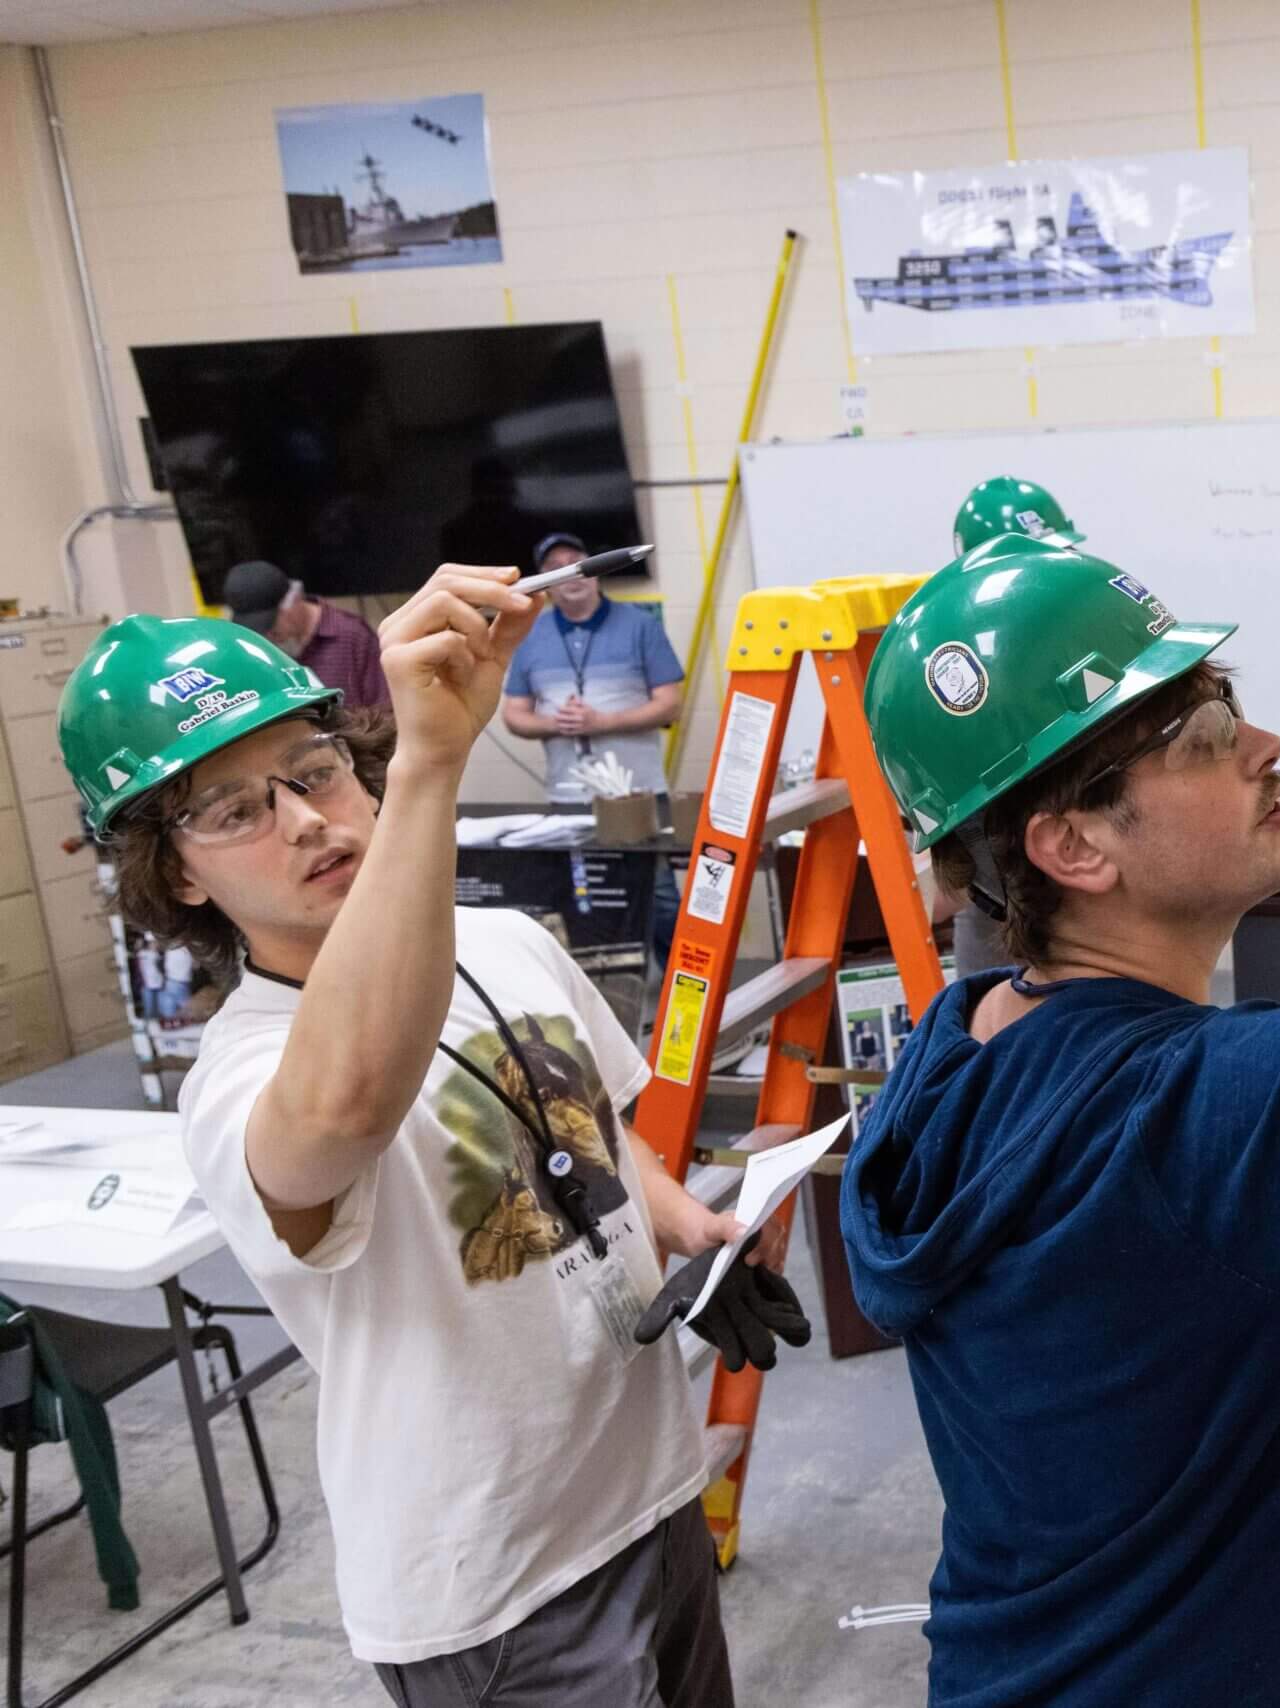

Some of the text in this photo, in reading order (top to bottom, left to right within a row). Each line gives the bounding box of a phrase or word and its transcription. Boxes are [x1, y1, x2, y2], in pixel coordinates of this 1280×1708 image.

[174, 670, 208, 693] BIW
[197, 692, 225, 708] D/19
[180, 706, 221, 731] Gabriel
